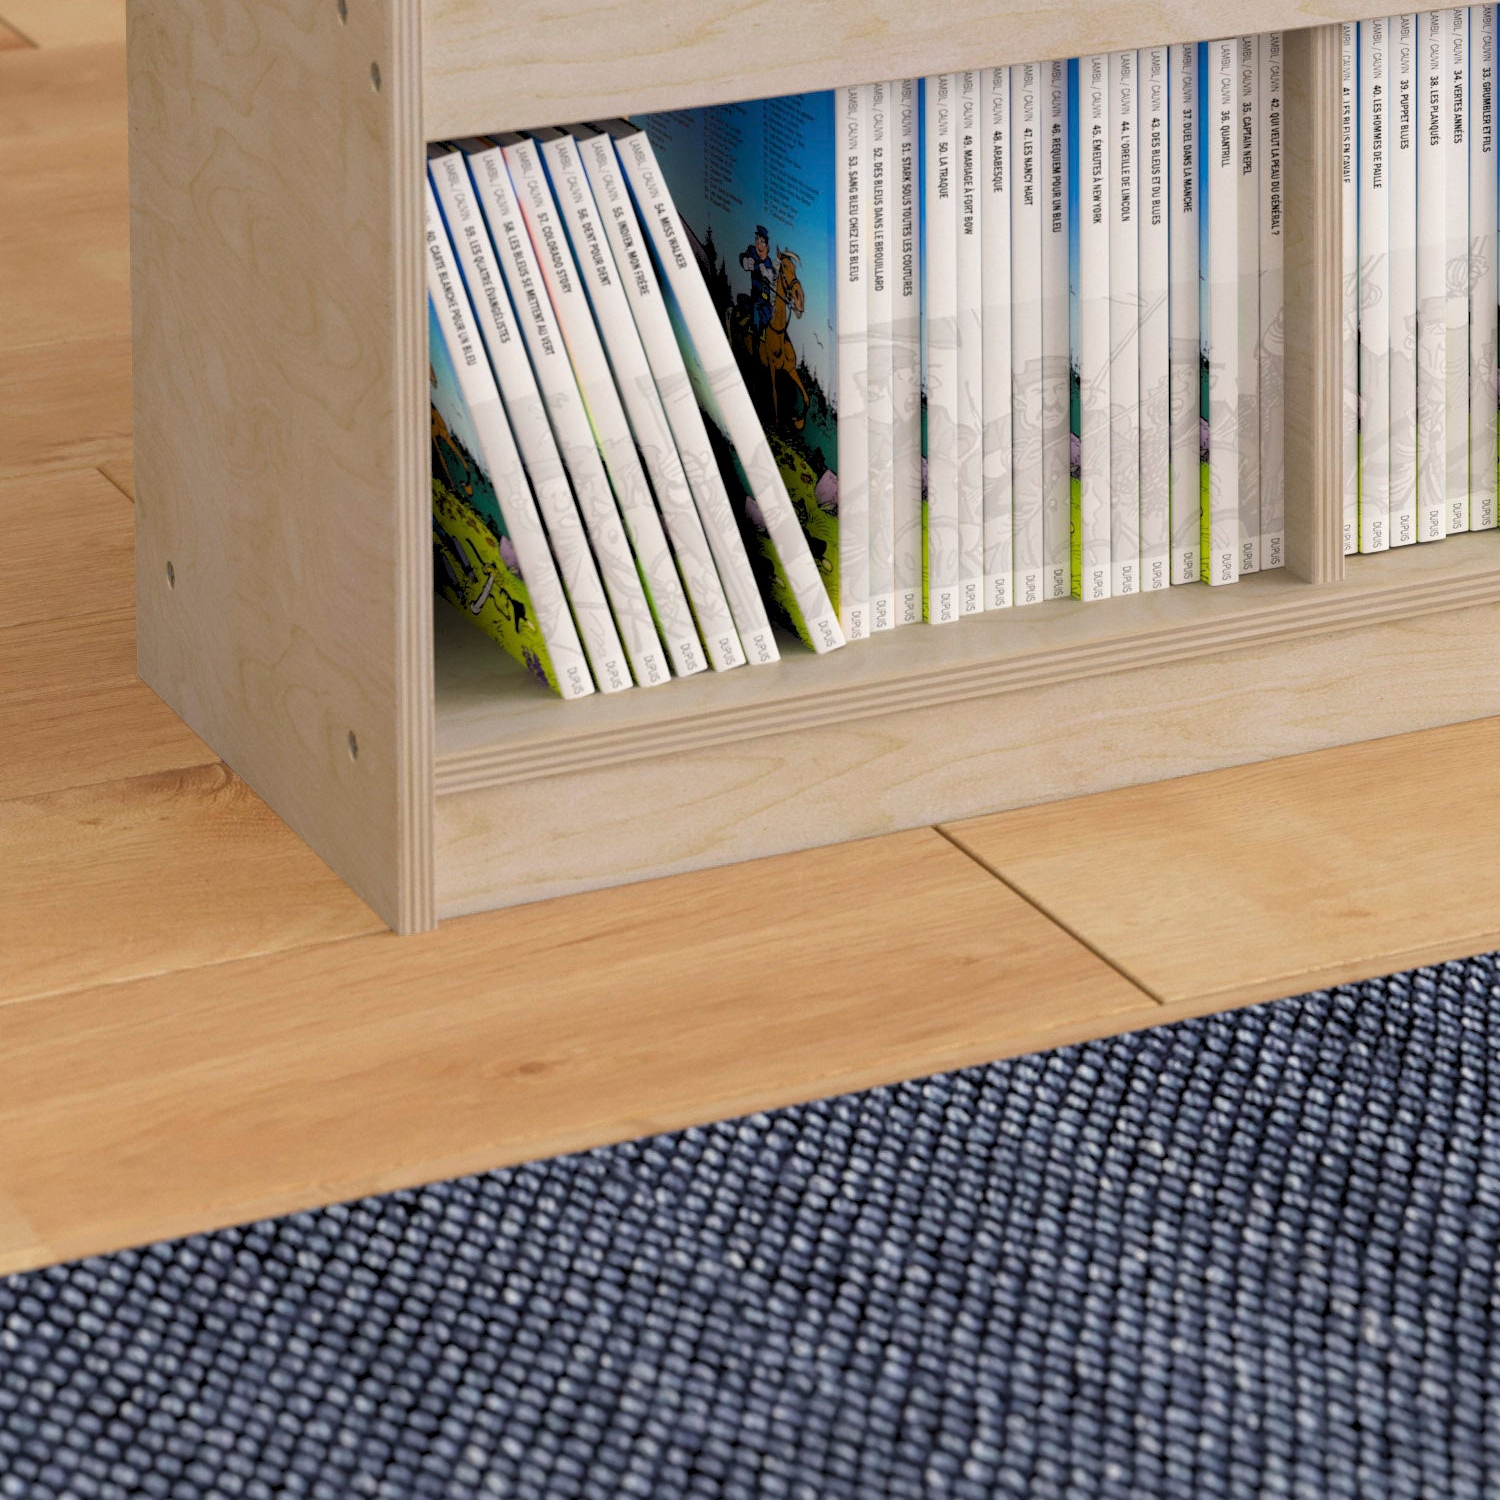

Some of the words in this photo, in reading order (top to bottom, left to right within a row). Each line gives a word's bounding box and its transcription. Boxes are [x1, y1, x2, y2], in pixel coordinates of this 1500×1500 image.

[1481, 68, 1492, 80] 33.
[1399, 80, 1410, 93] 39.
[1270, 98, 1281, 111] 42.
[1399, 93, 1410, 122] PUPPET
[1481, 81, 1492, 124] GRUMBLER
[1220, 110, 1231, 124] 36.
[1270, 112, 1281, 126] QUI
[992, 130, 1003, 144] 48.
[1050, 123, 1062, 137] 46.
[1091, 124, 1102, 138] 45.
[1270, 127, 1281, 146] VEUT
[1399, 124, 1410, 150] BLUES
[1481, 125, 1492, 134] ET
[901, 143, 912, 156] 51.
[1220, 125, 1231, 168] QUANTRILL
[1270, 148, 1281, 158] LA
[1481, 135, 1492, 153] FILS
[1050, 137, 1062, 174] REQUIEM
[1091, 139, 1105, 176] ÉMEUTES
[901, 156, 912, 182] STARK
[992, 145, 1003, 193] ARABESQUE
[1270, 158, 1281, 180] PEAU
[901, 183, 912, 206] SOUS
[1051, 175, 1062, 197] POUR
[1091, 184, 1102, 201] NEW
[1270, 180, 1281, 192] DU
[577, 208, 588, 222] 56.
[1051, 199, 1062, 211] UN
[1091, 202, 1102, 224] YORK
[1270, 194, 1284, 228] GÉNÉRAL
[503, 221, 514, 236] 58.
[537, 212, 548, 226] 57.
[901, 206, 913, 236] TOUTES
[1051, 212, 1062, 233] BLEU
[508, 235, 519, 250] LES
[582, 222, 594, 243] DENT
[655, 202, 665, 217] 54.
[660, 216, 673, 237] MISS
[668, 237, 686, 270] WALKER
[542, 226, 562, 269] COLORADO
[589, 243, 602, 265] POUR
[902, 238, 913, 253] LES
[513, 251, 528, 277] BLEUS
[522, 277, 531, 289] SE
[557, 269, 571, 295] STORY
[597, 266, 609, 287] DENT
[902, 254, 913, 297] COUTURES
[525, 289, 543, 324] METTENT
[537, 324, 547, 336] AU
[541, 336, 553, 356] VERT
